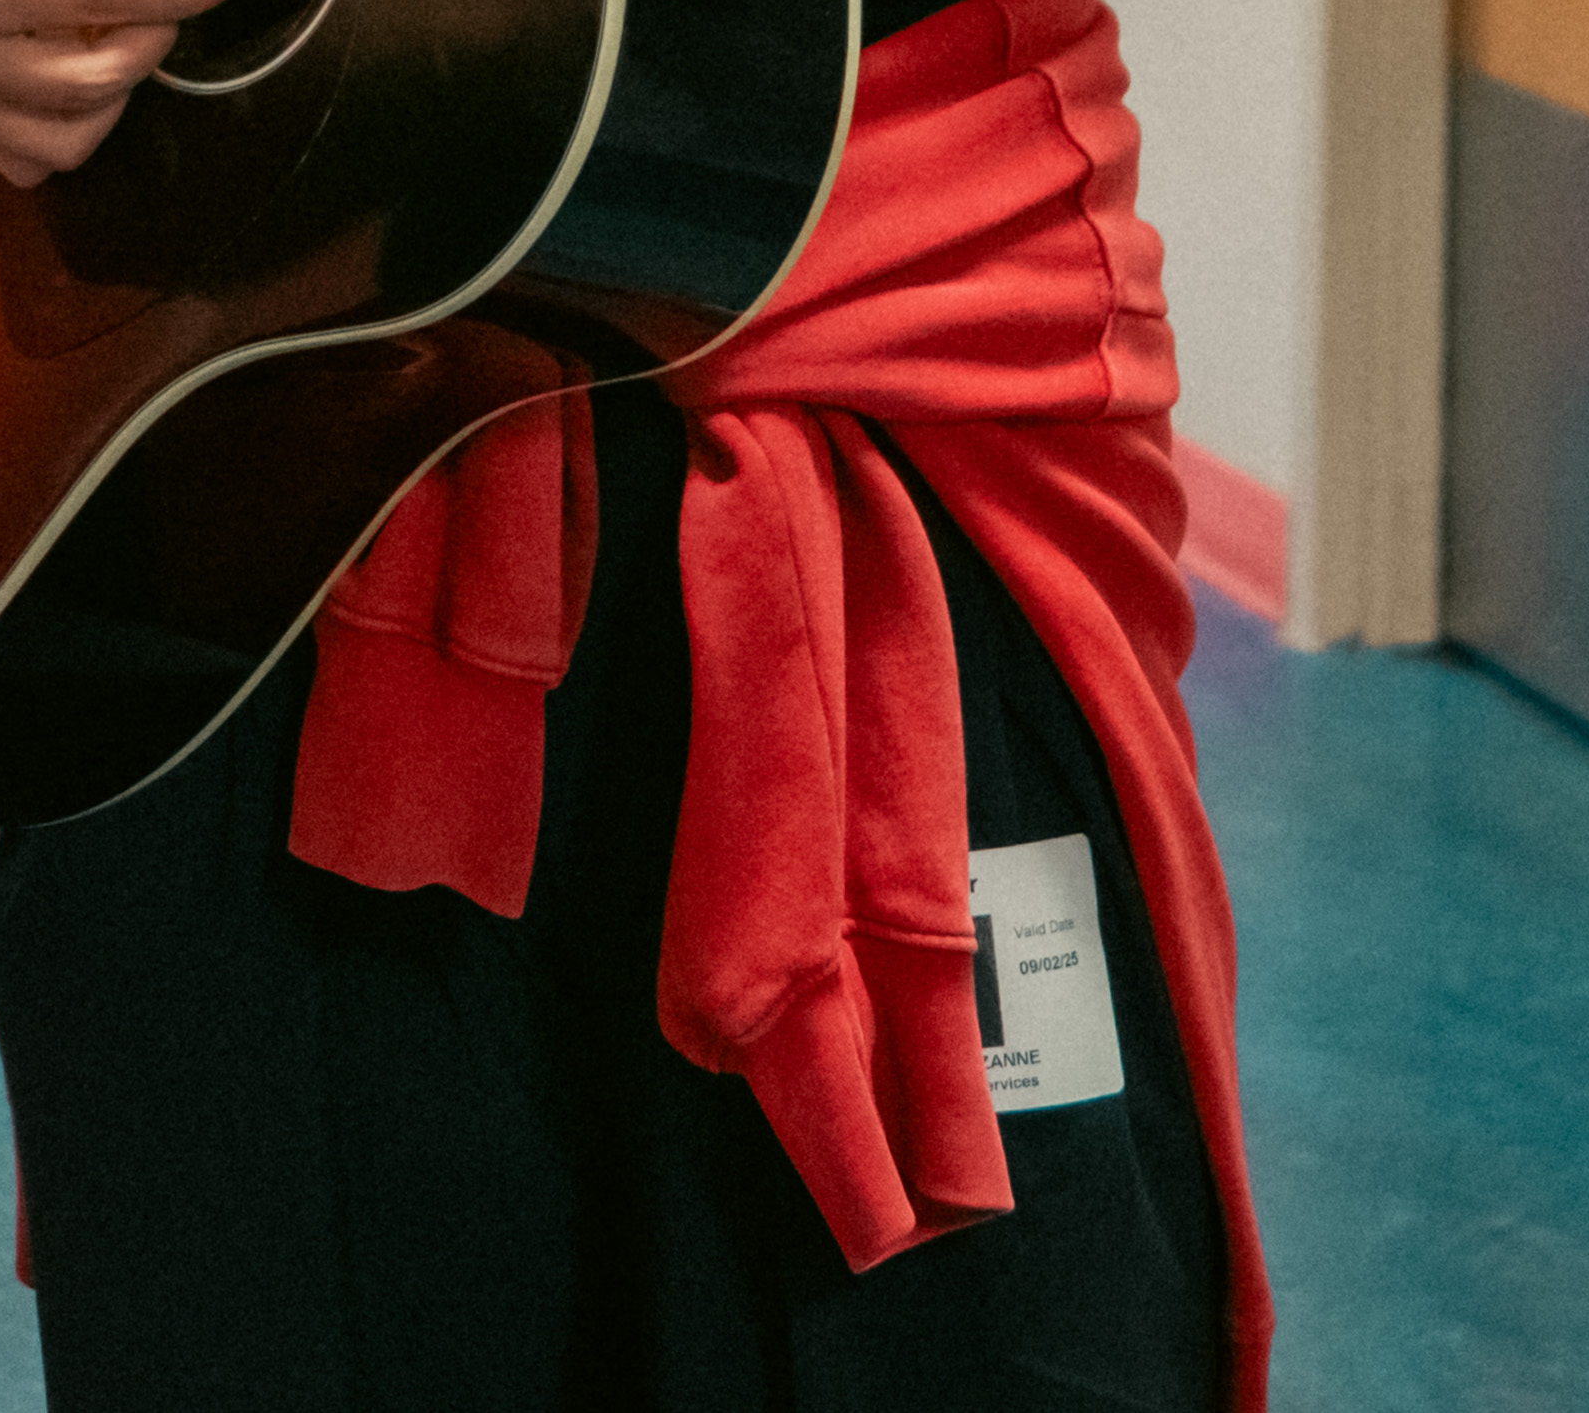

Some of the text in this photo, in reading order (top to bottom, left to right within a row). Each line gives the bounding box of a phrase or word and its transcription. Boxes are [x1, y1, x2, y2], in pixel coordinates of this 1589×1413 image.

[1014, 918, 1075, 939] Valid Date
[1019, 950, 1079, 975] 09/02/25
